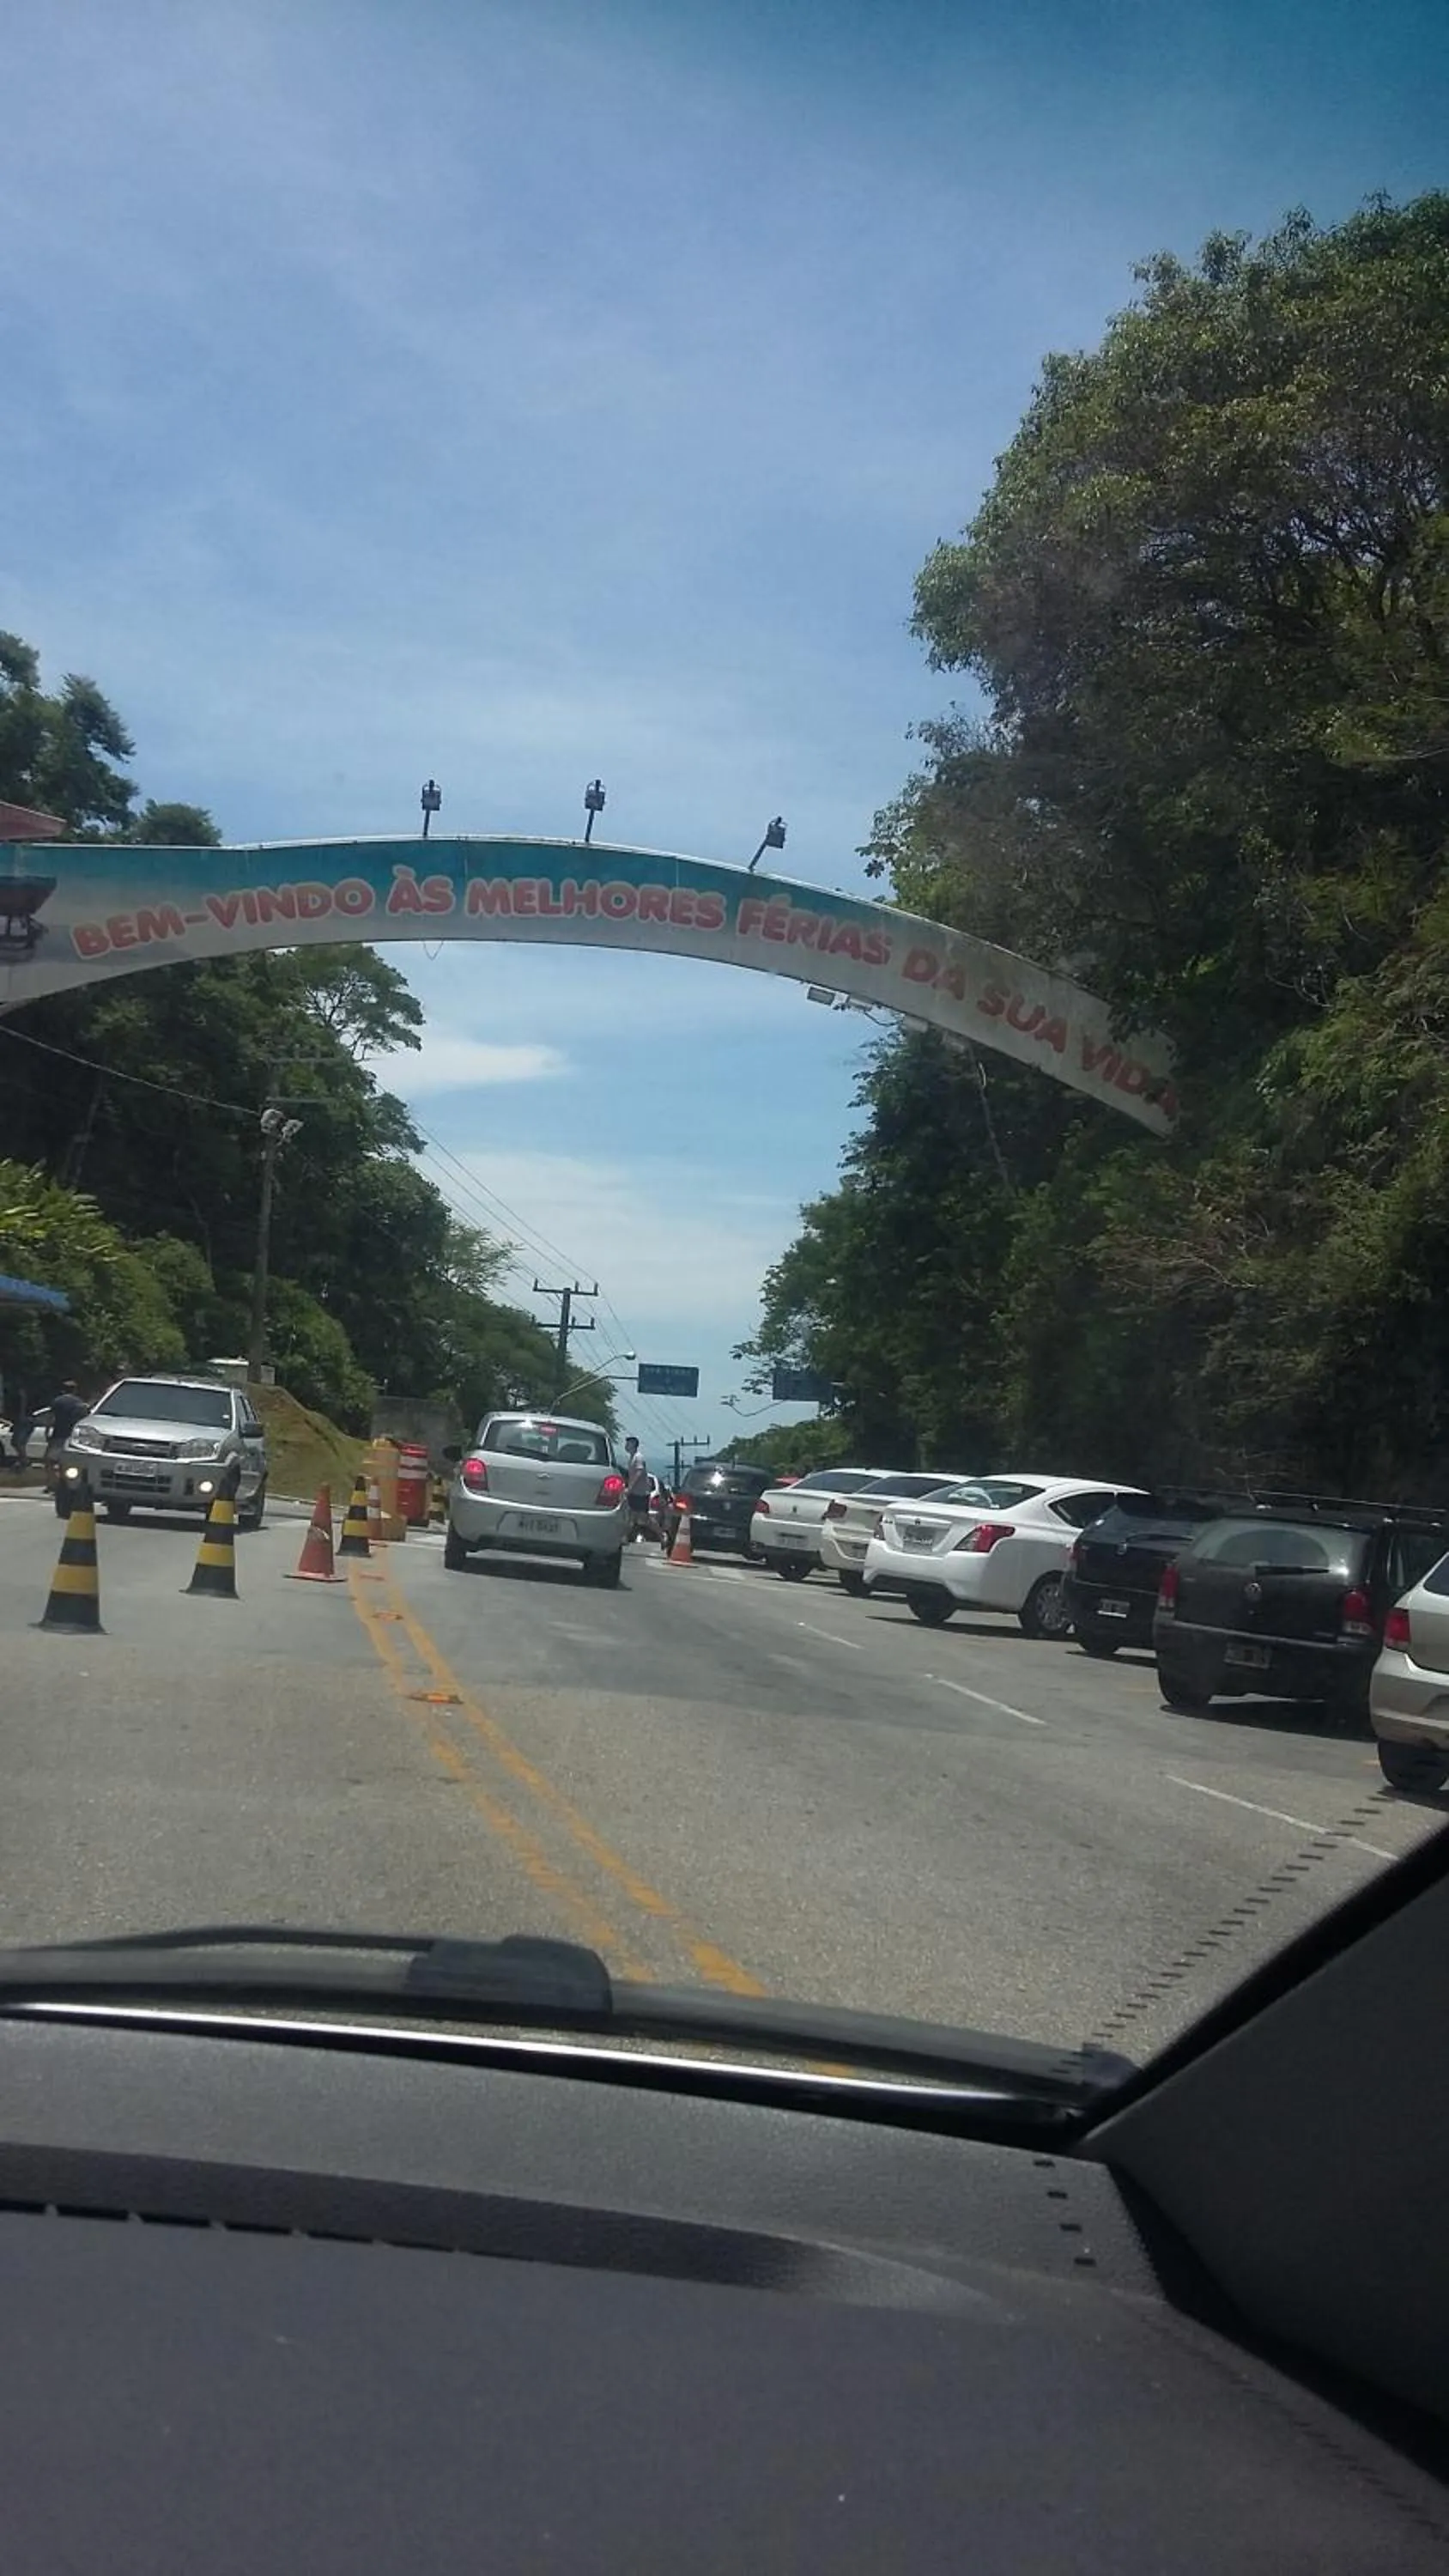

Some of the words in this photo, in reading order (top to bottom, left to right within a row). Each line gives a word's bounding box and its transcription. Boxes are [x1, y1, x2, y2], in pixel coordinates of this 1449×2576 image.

[72, 879, 373, 958] BEM-VINDO
[387, 866, 453, 915] ÀS
[465, 877, 726, 930] MELHORES
[736, 895, 892, 966] FÉRIAS
[900, 950, 966, 1001] DA
[977, 983, 1068, 1054] SUA
